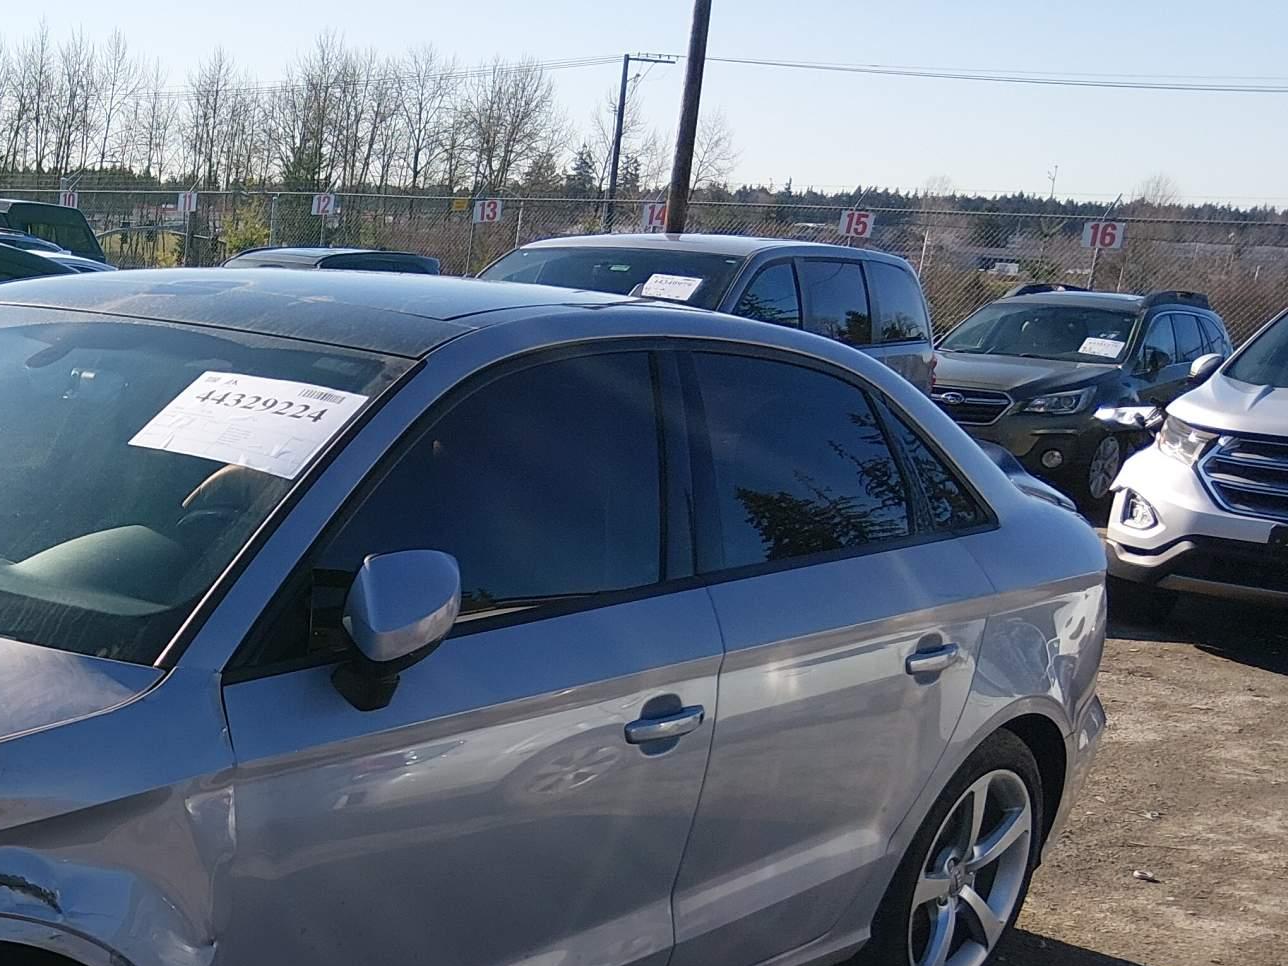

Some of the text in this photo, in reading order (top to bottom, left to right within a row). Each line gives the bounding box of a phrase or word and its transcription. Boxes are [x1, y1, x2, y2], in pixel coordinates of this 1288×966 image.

[62, 192, 76, 208] 10
[184, 192, 192, 211] 11
[316, 195, 330, 214] 12
[479, 200, 498, 223] 13
[648, 204, 666, 225] 14
[845, 211, 869, 236] 15
[1090, 223, 1117, 247] 16
[195, 389, 329, 423] 44329224
